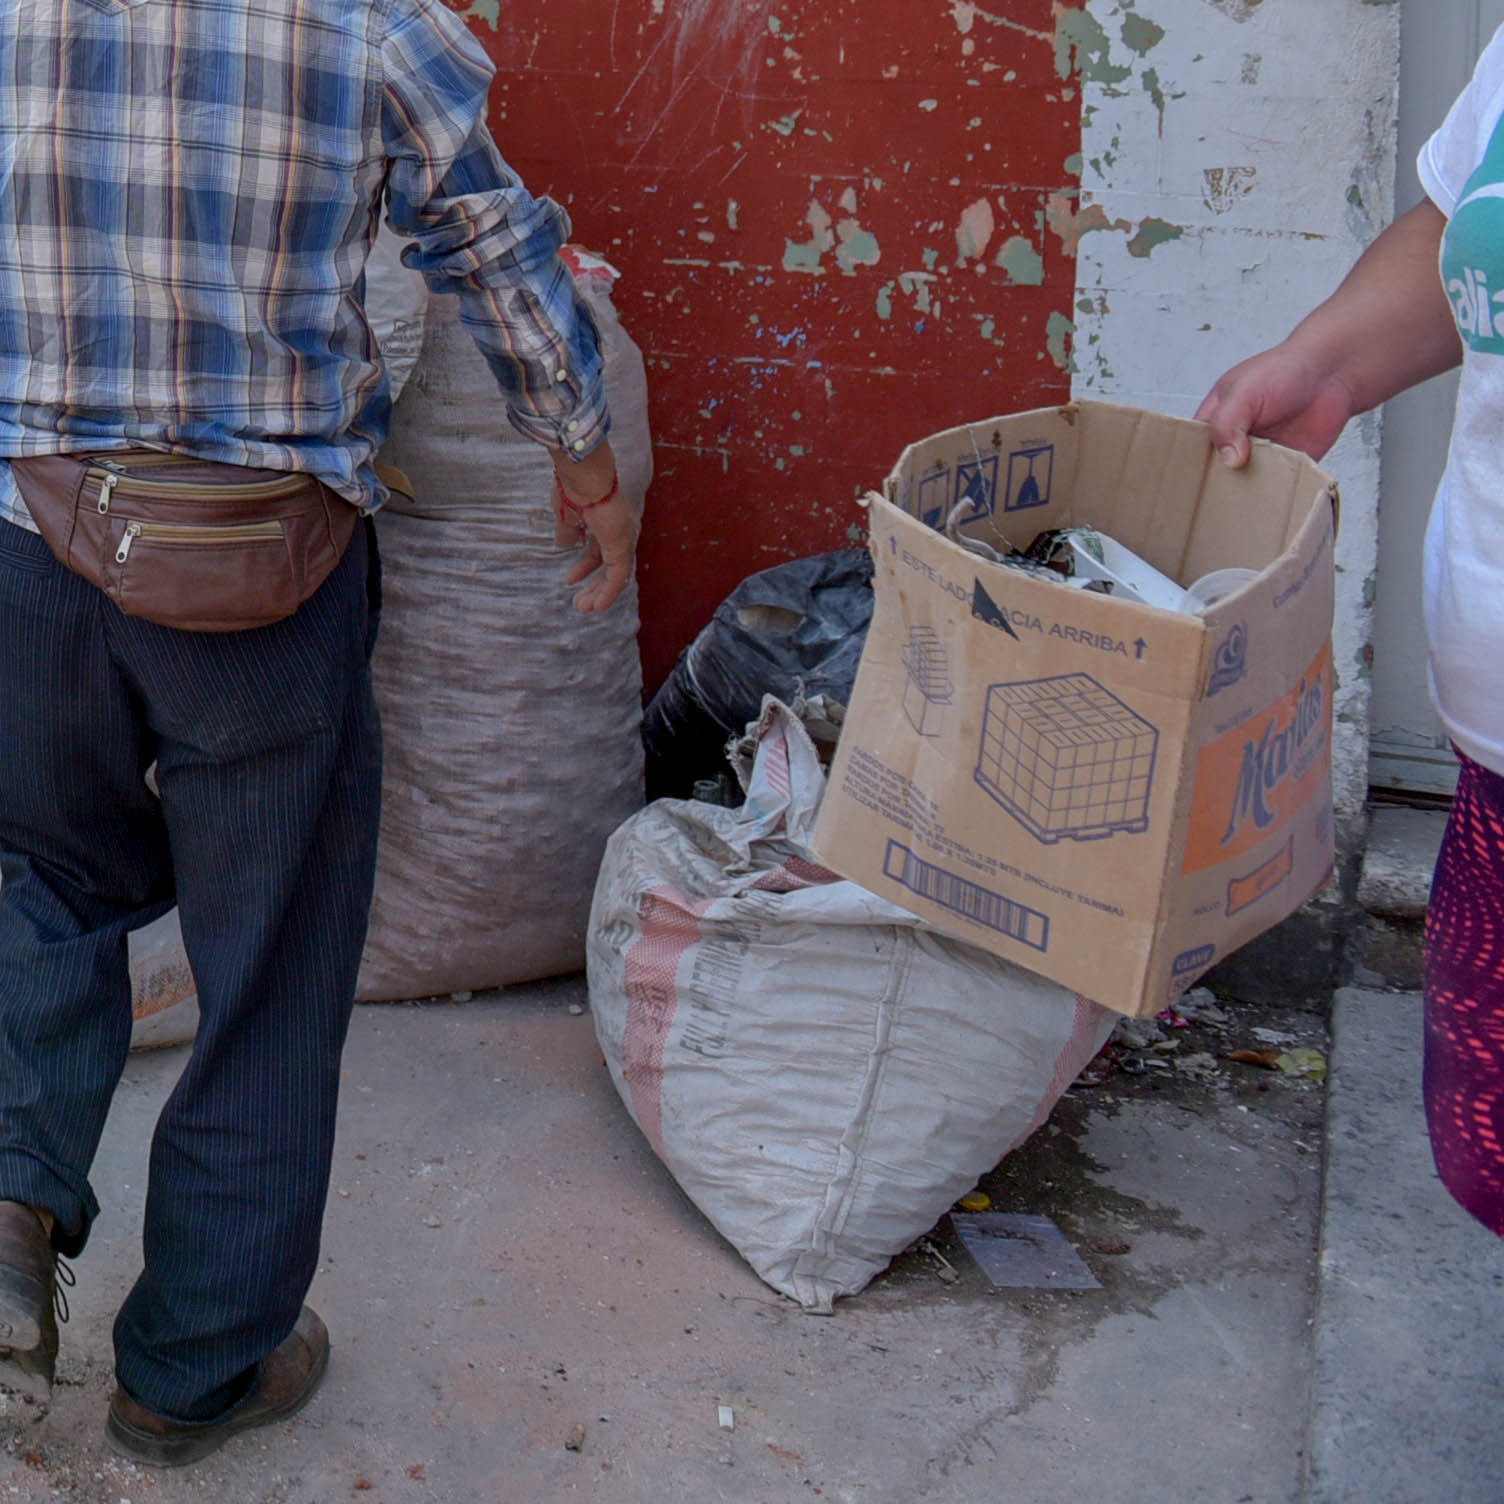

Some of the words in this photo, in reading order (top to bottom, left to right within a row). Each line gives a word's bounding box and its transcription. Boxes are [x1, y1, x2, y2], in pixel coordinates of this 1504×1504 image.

[902, 549, 938, 584] ESTE
[998, 605, 1045, 634] ACIA
[1047, 622, 1129, 657] ARRIBA
